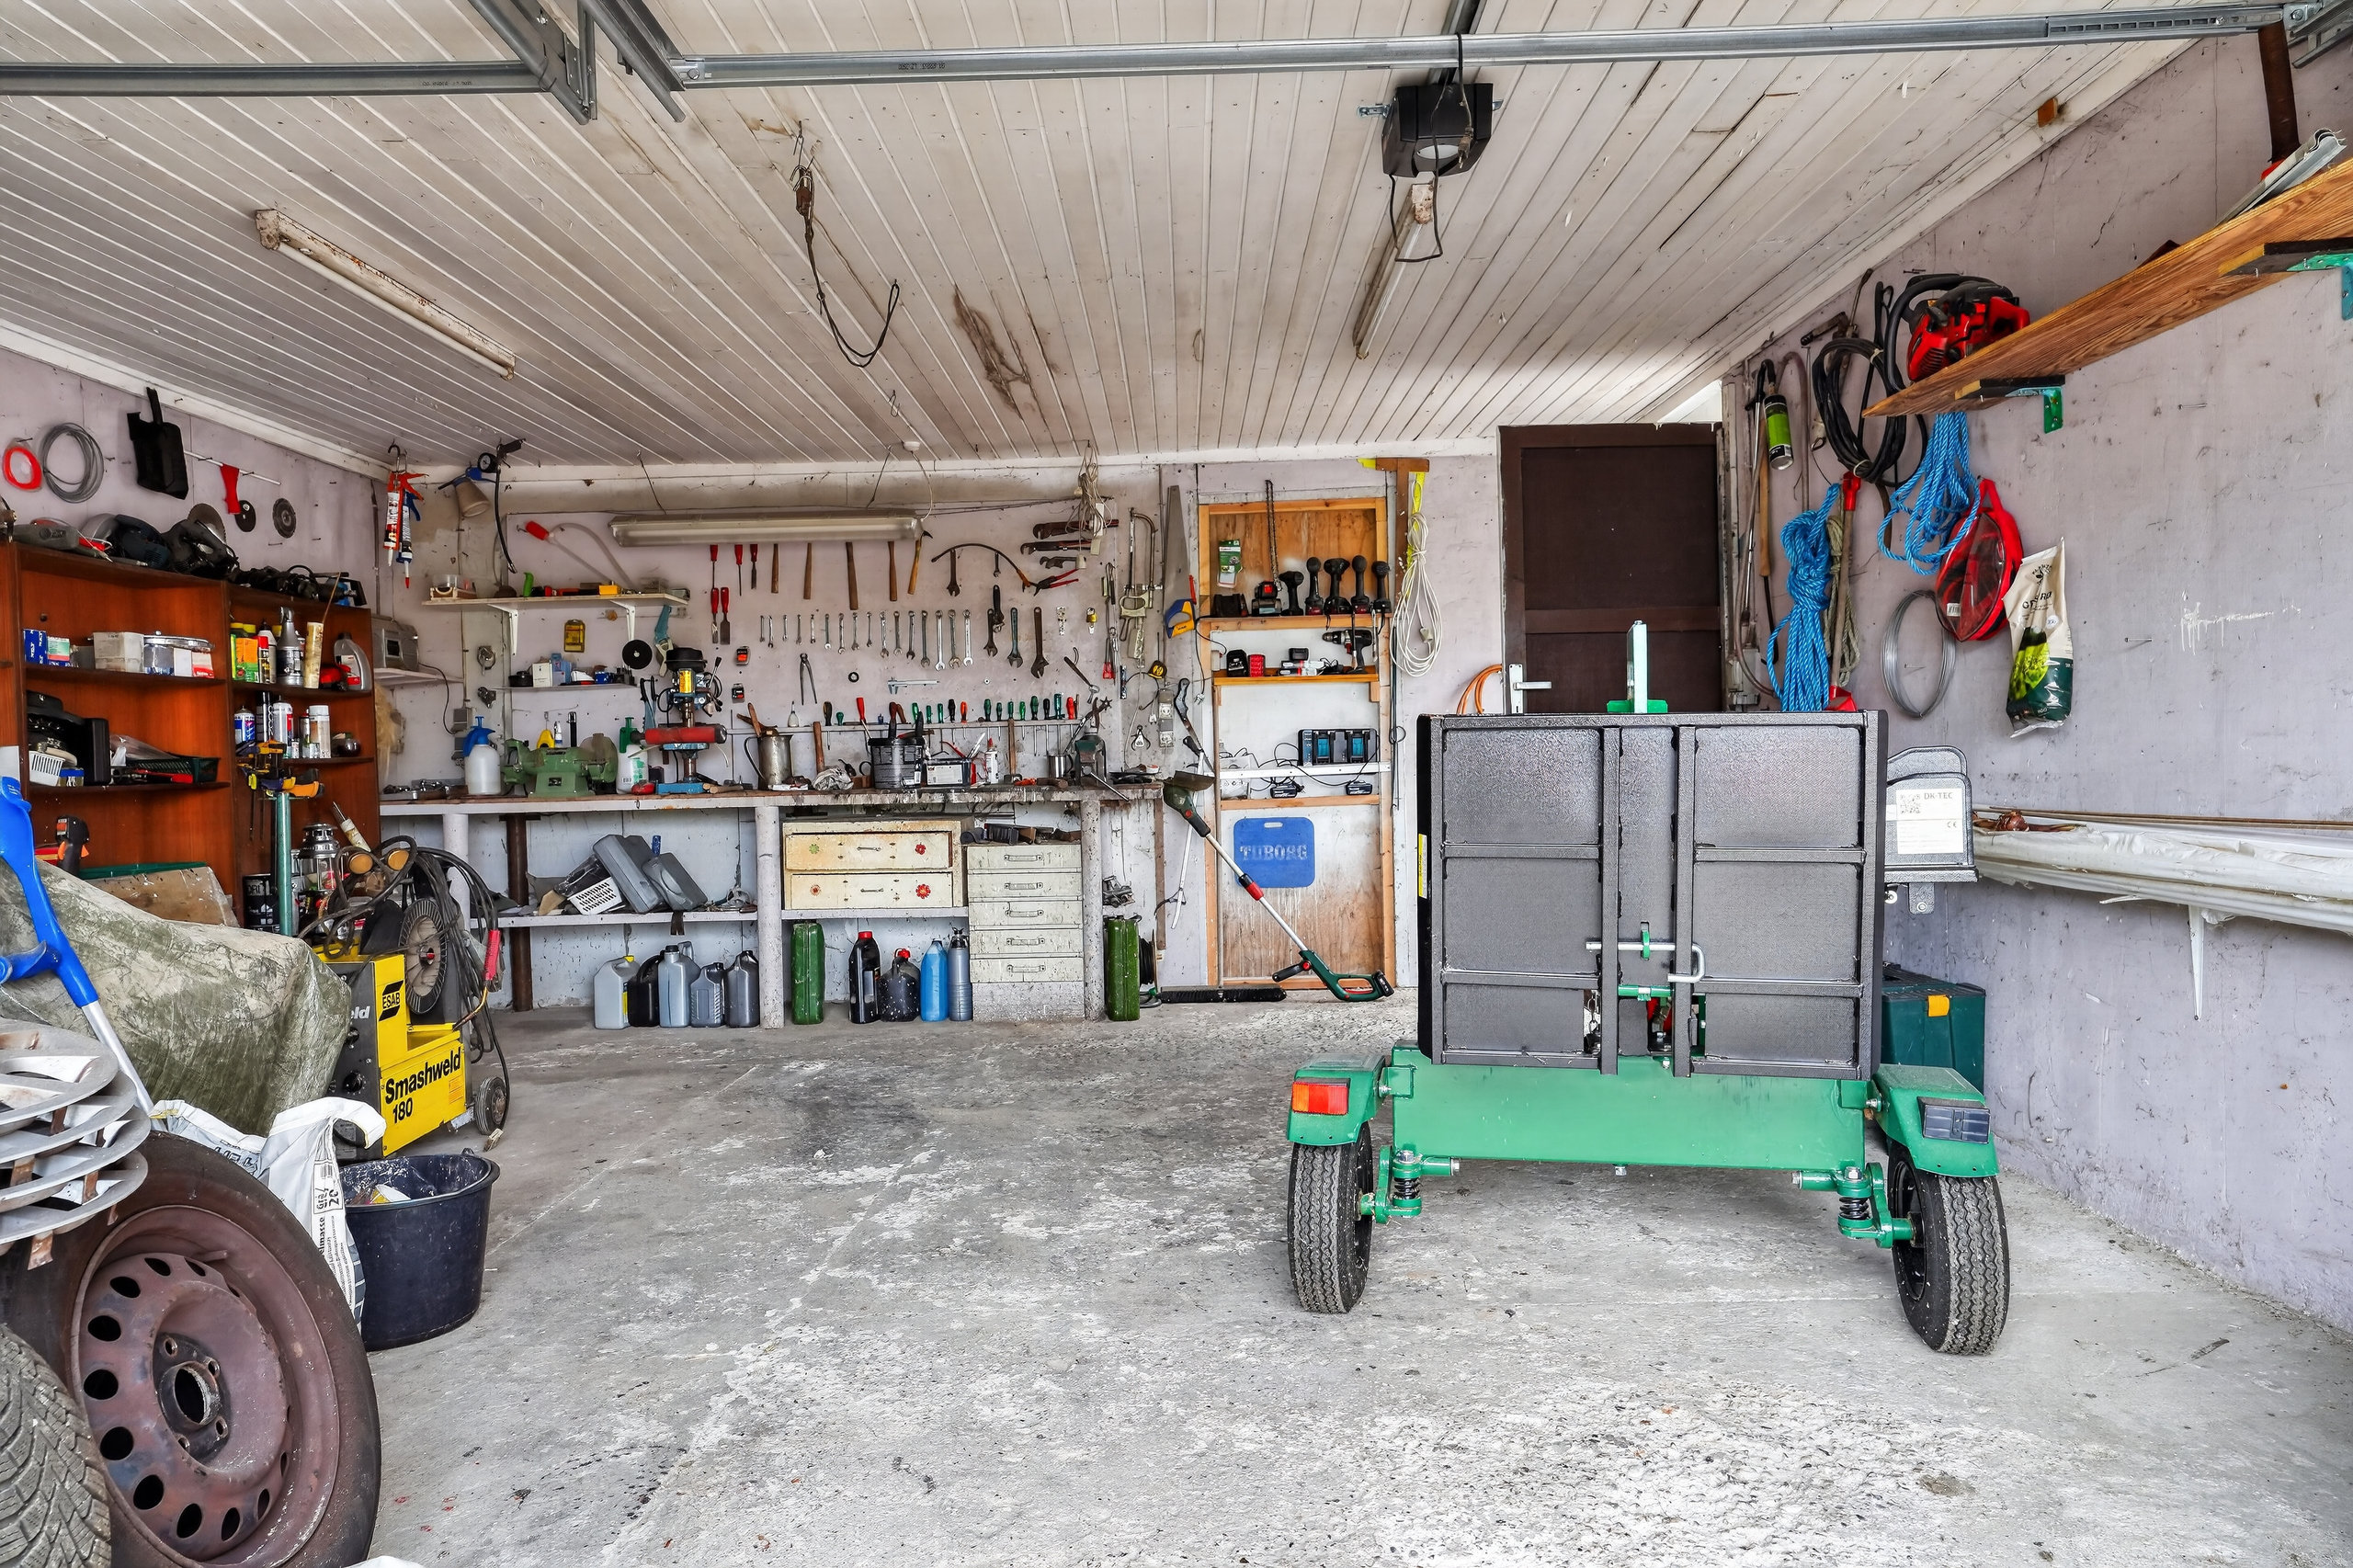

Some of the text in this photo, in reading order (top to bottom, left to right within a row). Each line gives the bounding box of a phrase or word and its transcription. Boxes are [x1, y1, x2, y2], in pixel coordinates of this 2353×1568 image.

[1924, 791, 1953, 800] DK-TEC
[1240, 845, 1308, 861] TUBORG
[382, 992, 401, 1009] ESAB
[385, 1047, 461, 1105] Smashweld
[392, 1096, 414, 1124] 180
